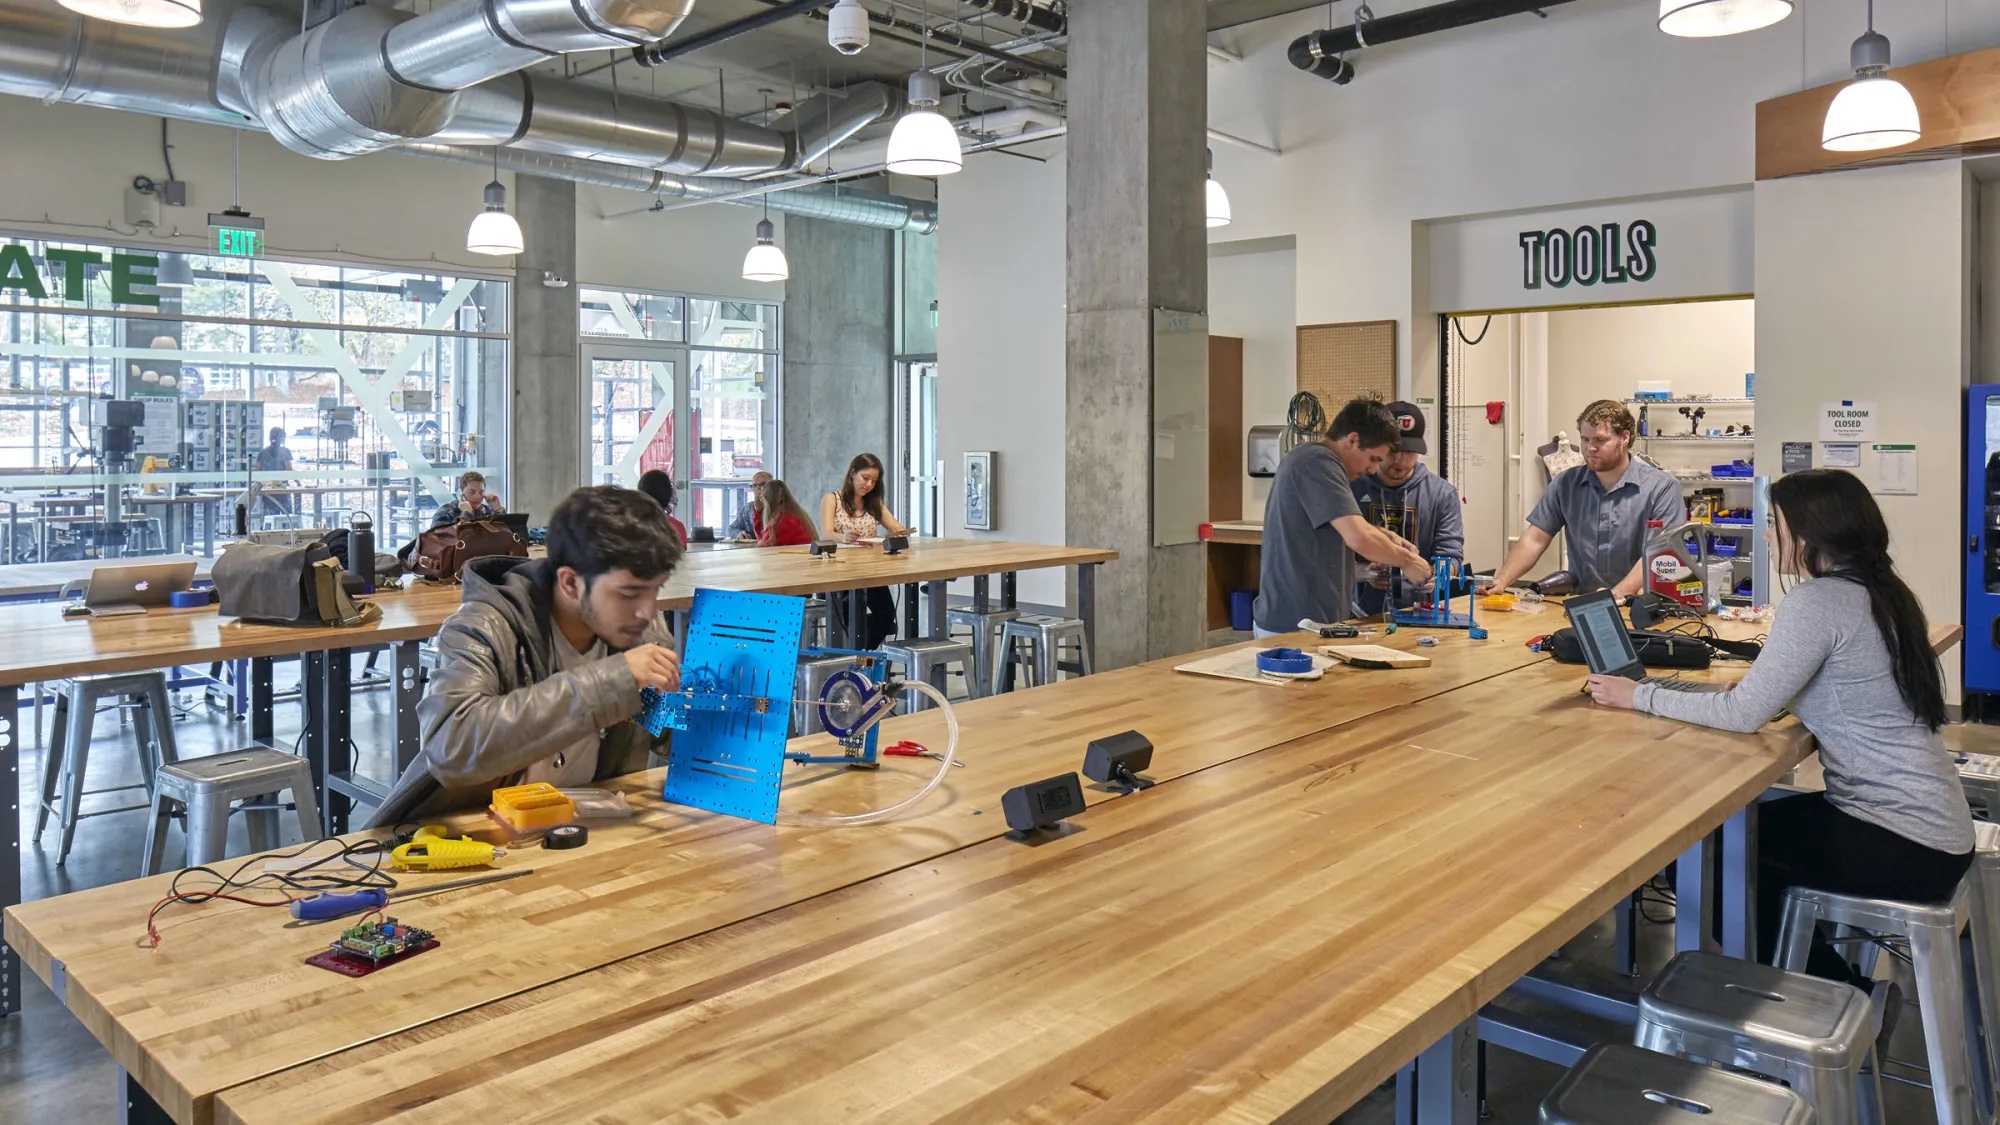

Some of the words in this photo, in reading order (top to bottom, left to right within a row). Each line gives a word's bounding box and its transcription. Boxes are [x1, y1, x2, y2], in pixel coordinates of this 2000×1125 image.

[219, 228, 256, 256] EXIT
[1519, 219, 1657, 290] TOOLS
[0, 244, 160, 306] ATE
